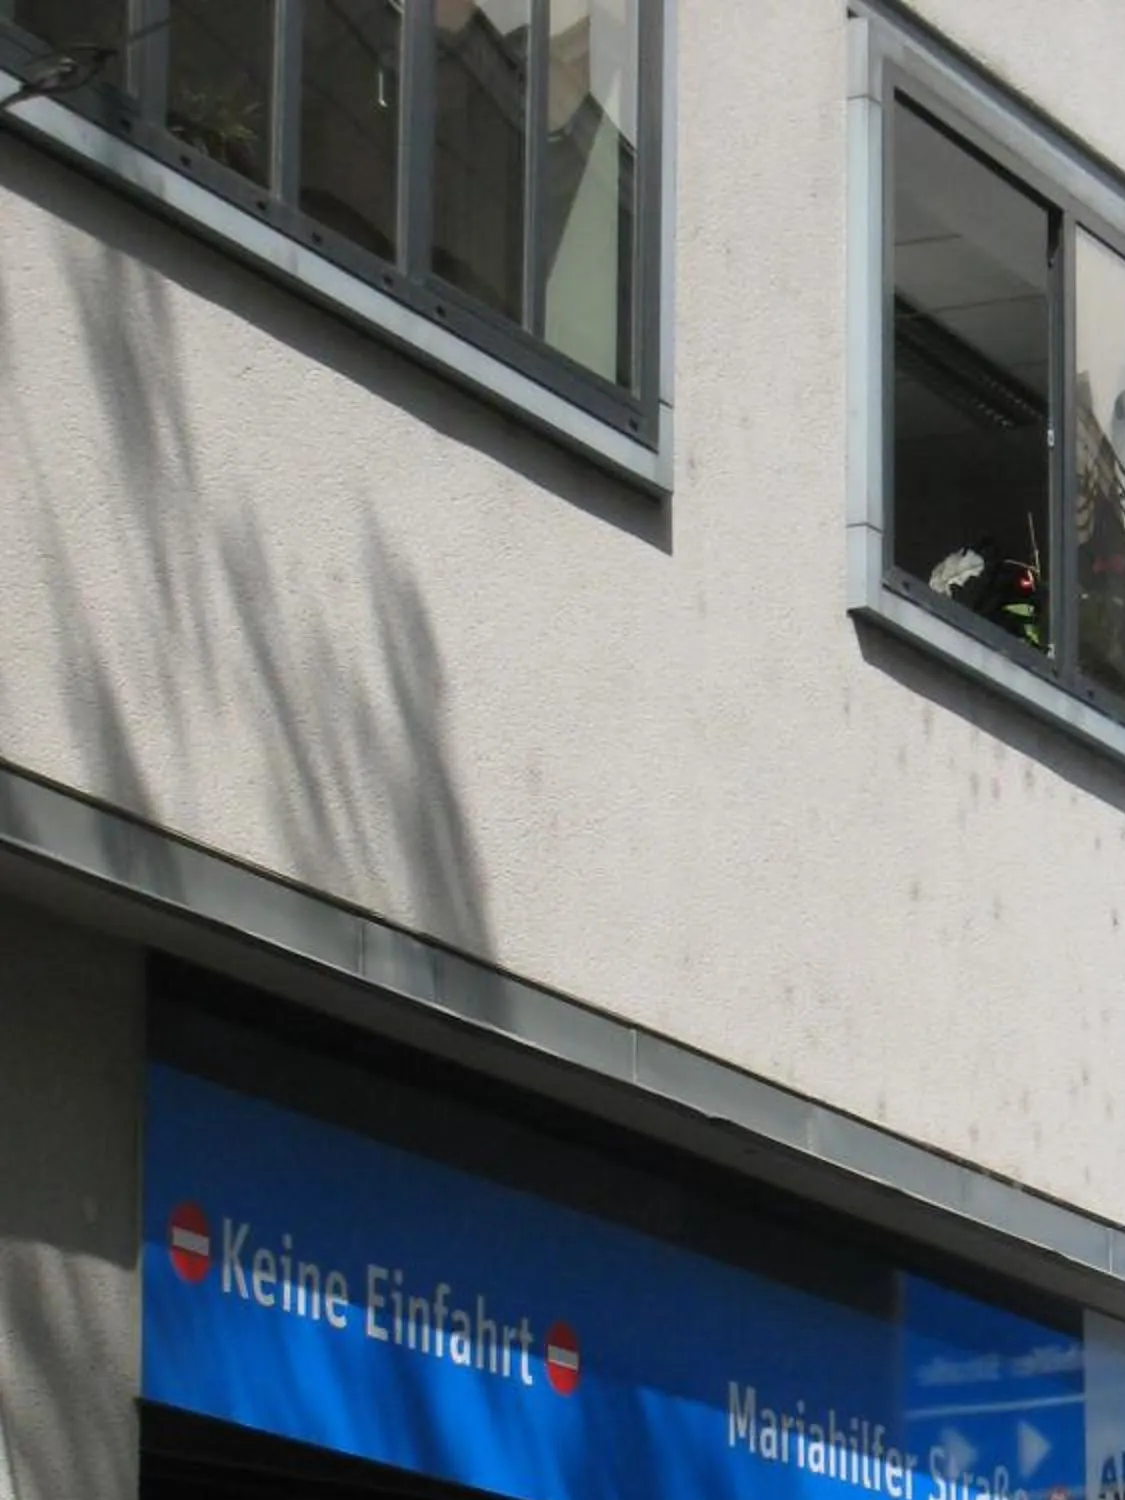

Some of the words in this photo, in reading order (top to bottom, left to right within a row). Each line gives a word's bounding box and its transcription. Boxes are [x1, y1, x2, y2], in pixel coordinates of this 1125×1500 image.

[221, 1218, 349, 1328] Keine
[365, 1263, 534, 1386] Einfahrt
[727, 1381, 916, 1500] Mariahilfer
